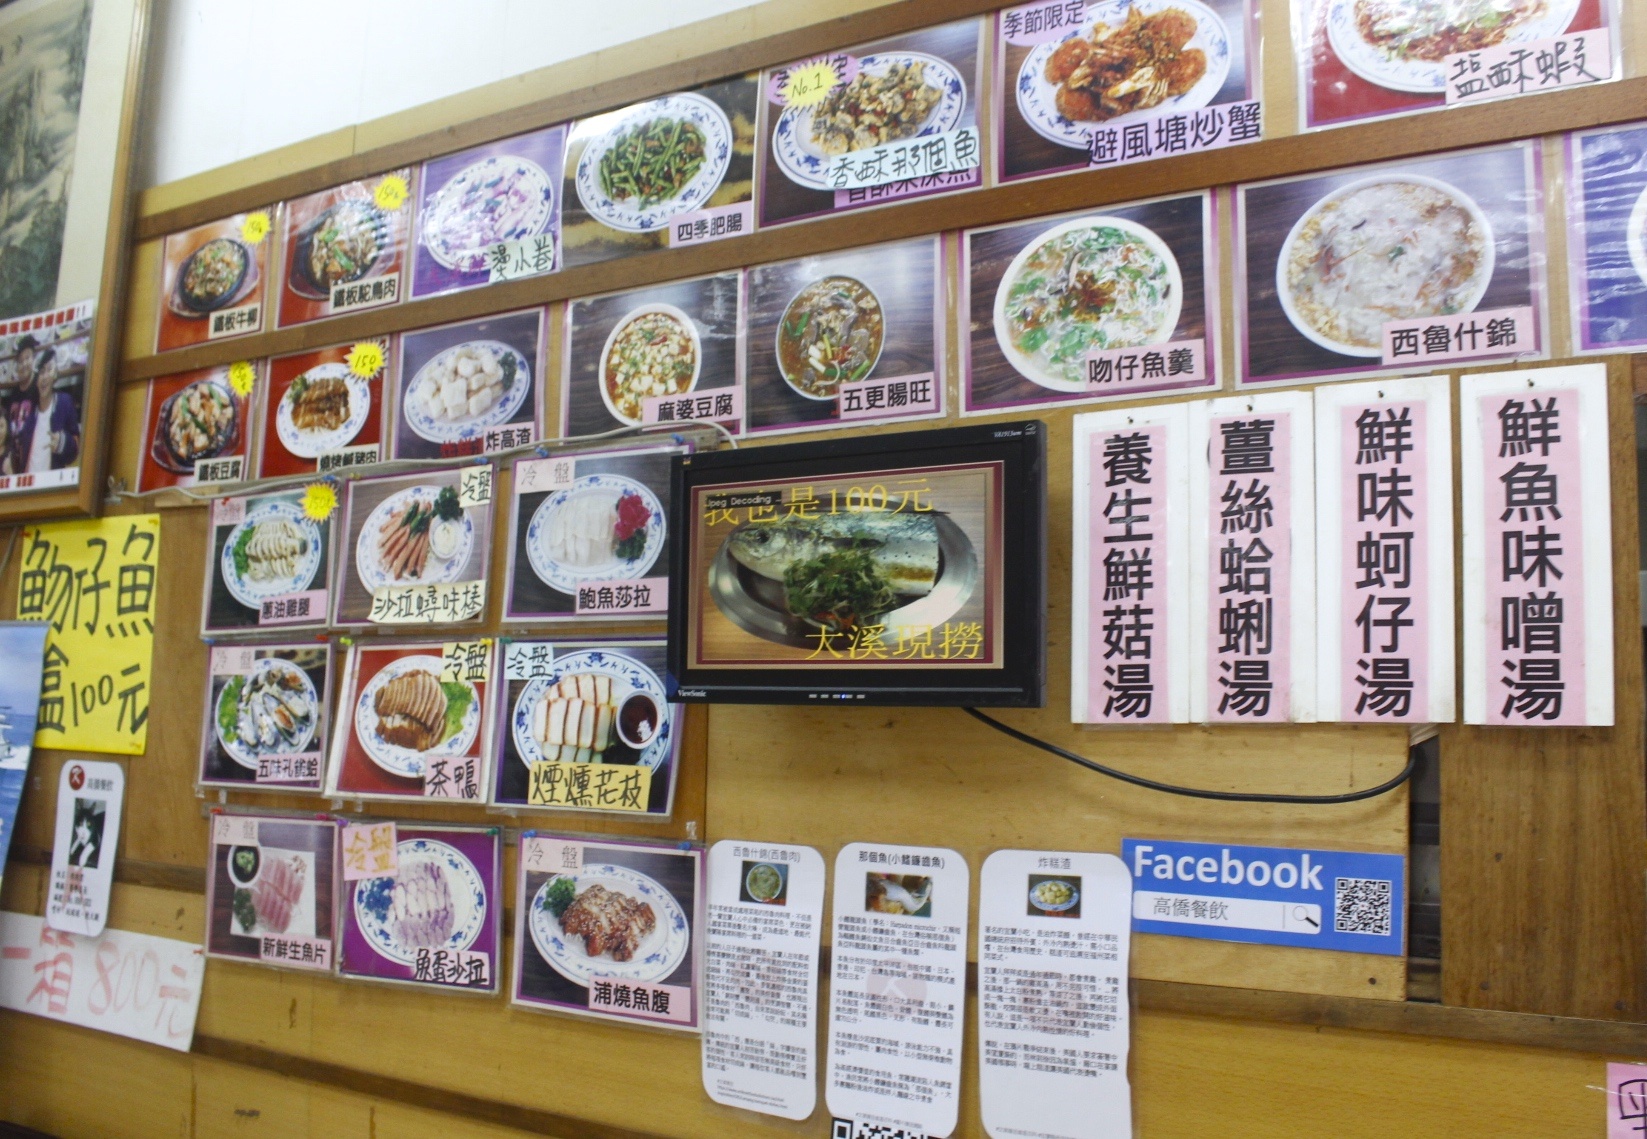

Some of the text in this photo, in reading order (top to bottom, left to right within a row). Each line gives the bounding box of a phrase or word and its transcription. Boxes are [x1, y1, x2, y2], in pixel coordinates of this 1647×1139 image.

[1004, 1, 1085, 38] 季節限定
[1085, 102, 1261, 167] 避風塘炒蟹
[832, 129, 979, 188] 香酥那個魚
[678, 212, 742, 241] 四季肥腸
[1390, 318, 1517, 357] 西魯什錦
[1088, 348, 1194, 383] 吻仔魚羹
[657, 393, 734, 421] 麻婆豆腐
[843, 379, 931, 412] 五更腸旺
[1102, 432, 1154, 719] 養生鮮菇湯
[1217, 419, 1275, 718] 薑絲蛤蜊湯
[1354, 407, 1414, 719] 鮮味蚵仔湯
[1496, 396, 1565, 722] 鮮魚味噌湯
[579, 584, 652, 610] 鮑魚莎拉
[805, 622, 983, 661] 大溪現撈
[1134, 845, 1323, 890] Facebook
[1153, 897, 1228, 921] 高僑餐飲
[263, 937, 326, 965] 新鮮生魚片
